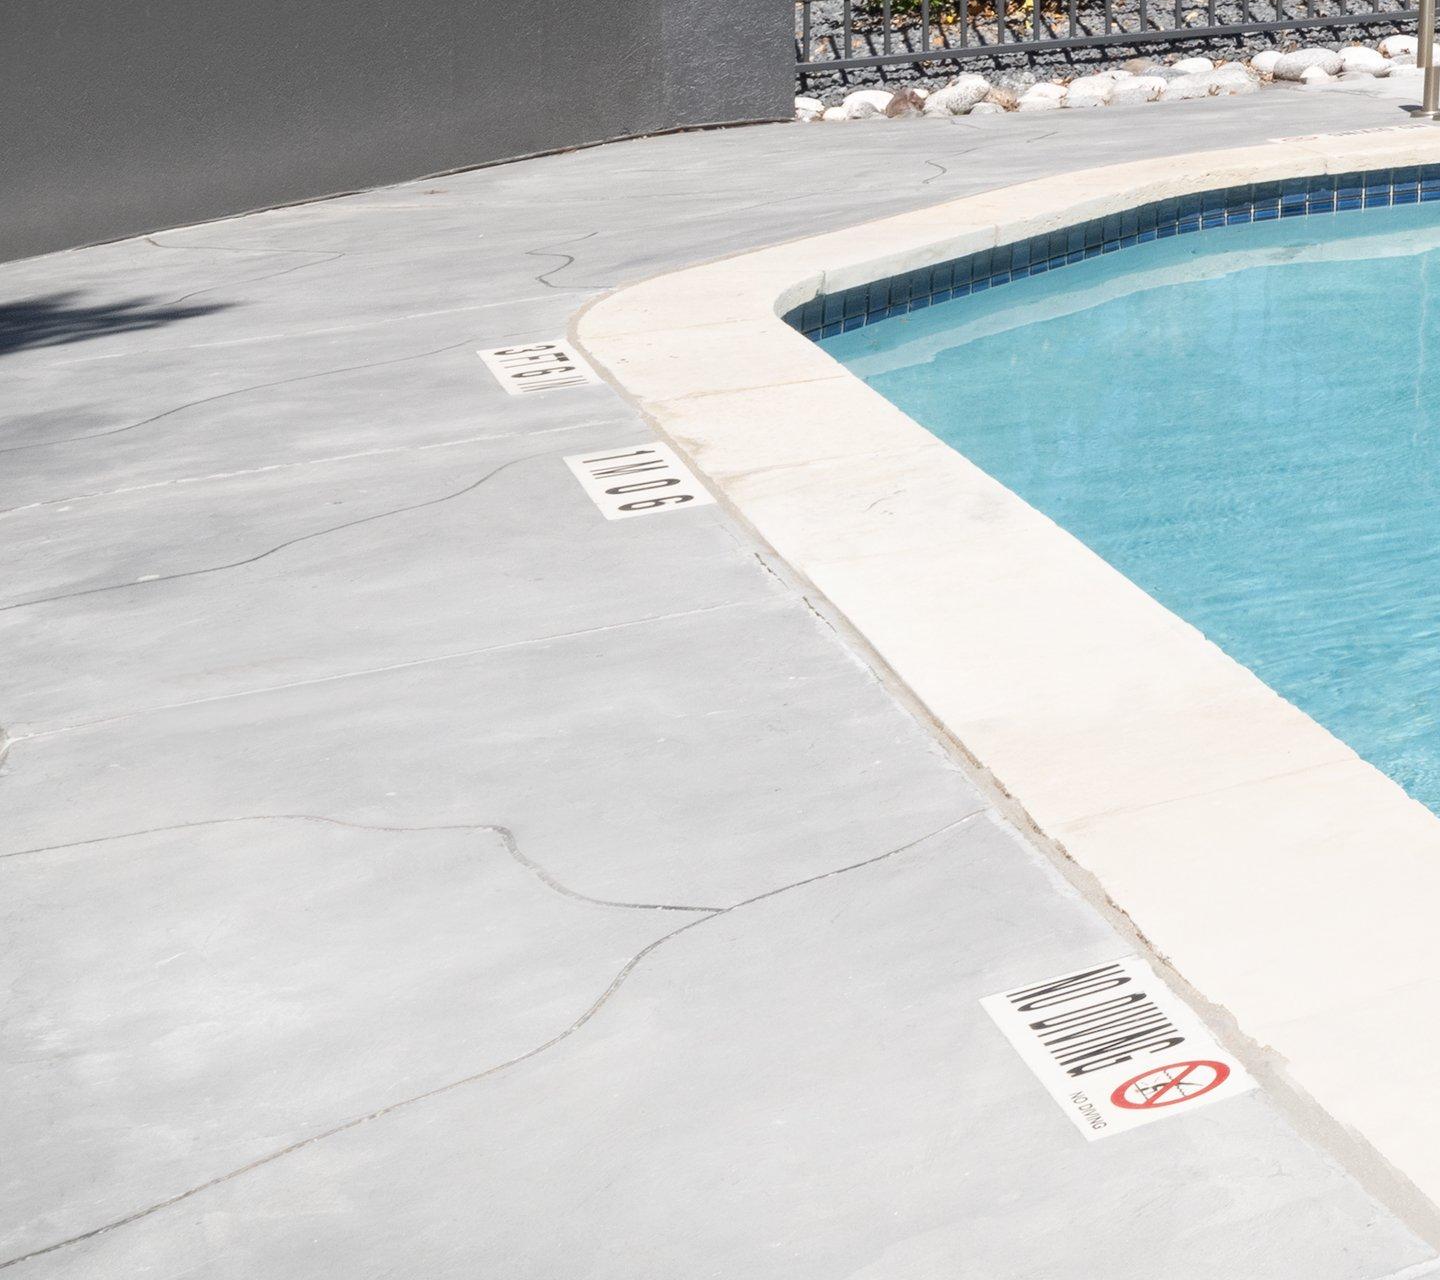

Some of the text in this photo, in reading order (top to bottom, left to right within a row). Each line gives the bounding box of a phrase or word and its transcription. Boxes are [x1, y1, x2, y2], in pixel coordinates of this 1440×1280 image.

[494, 344, 556, 356] 3
[511, 365, 576, 379] 6
[1006, 963, 1186, 1078] NO DIVING
